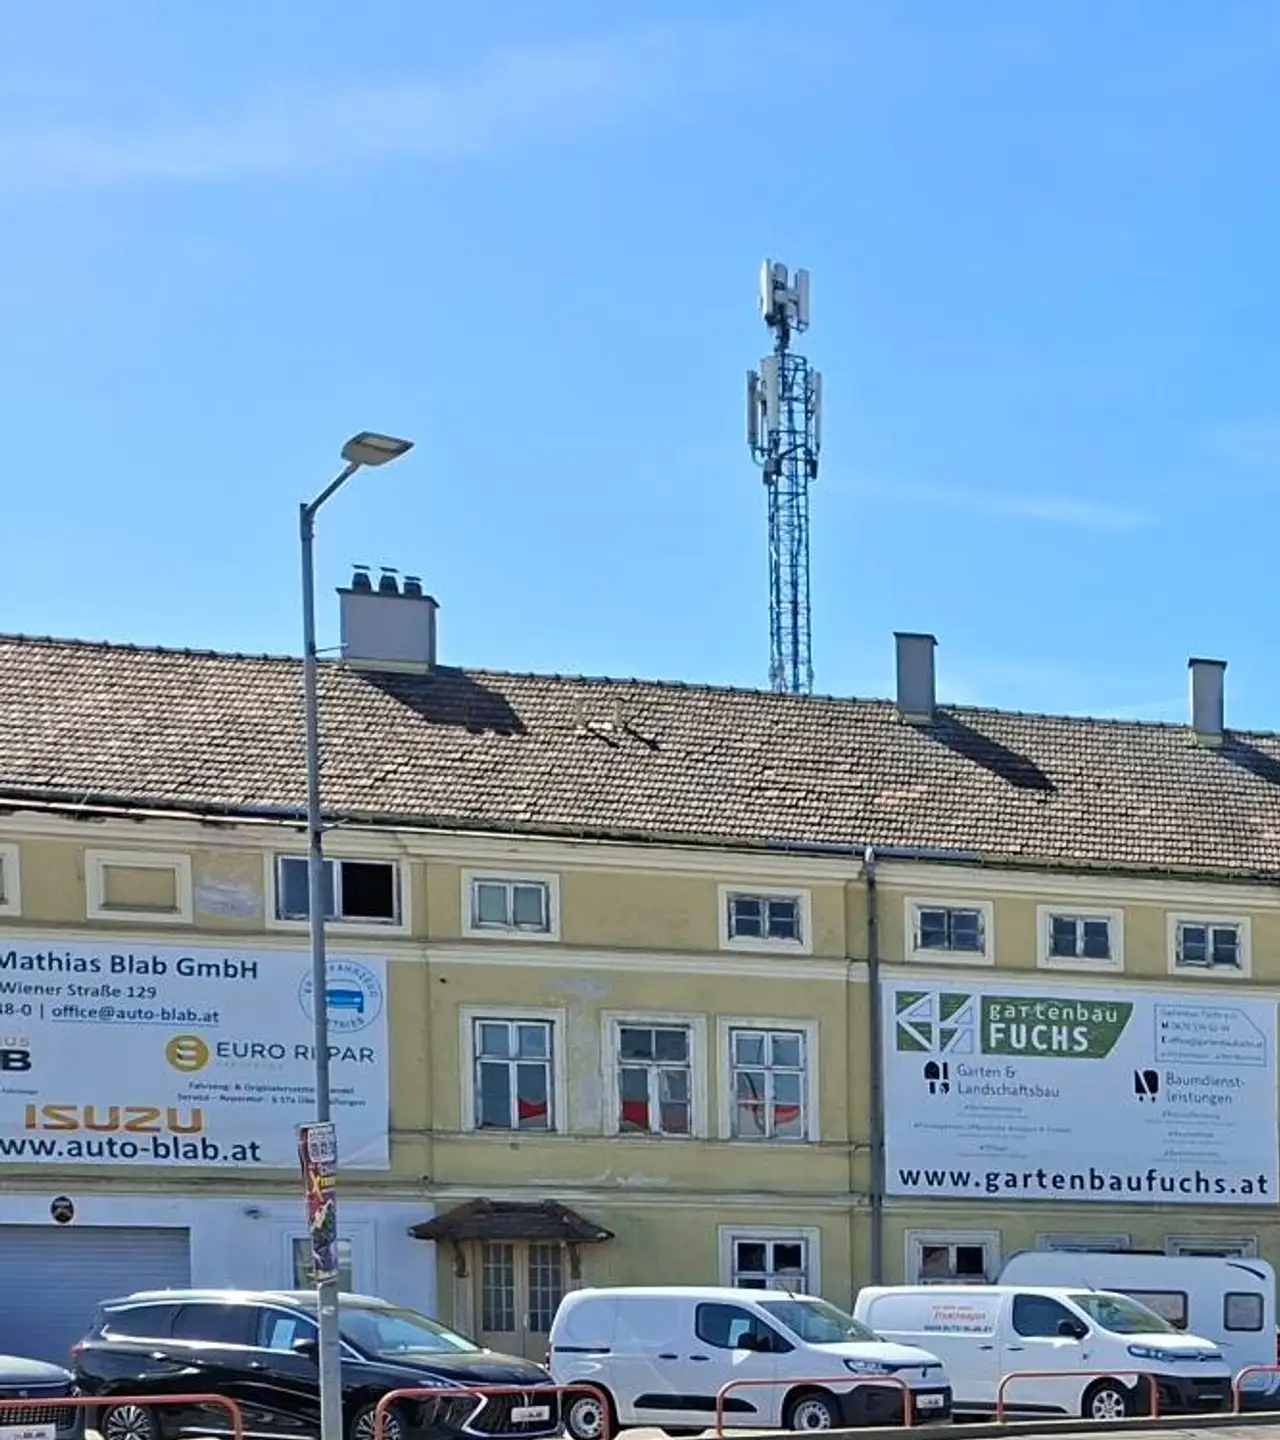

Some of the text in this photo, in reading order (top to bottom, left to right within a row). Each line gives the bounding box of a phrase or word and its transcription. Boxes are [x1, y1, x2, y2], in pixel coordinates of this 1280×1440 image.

[110, 954, 167, 976] Blab
[176, 957, 257, 979] GmbH
[0, 981, 157, 999] Wiener Straße 129
[52, 1004, 219, 1023] office@auto-blab.at
[989, 1001, 1118, 1023] gartenbau
[990, 1023, 1088, 1051] FUCHS
[216, 1042, 285, 1060] EURO
[957, 1063, 1001, 1078] Garten
[958, 1082, 1060, 1098] Landschaftsbau
[1167, 1090, 1232, 1105] leistungen
[25, 1104, 202, 1133] ISUZU
[898, 1168, 1269, 1195] www.gartenbaufuchs.at
